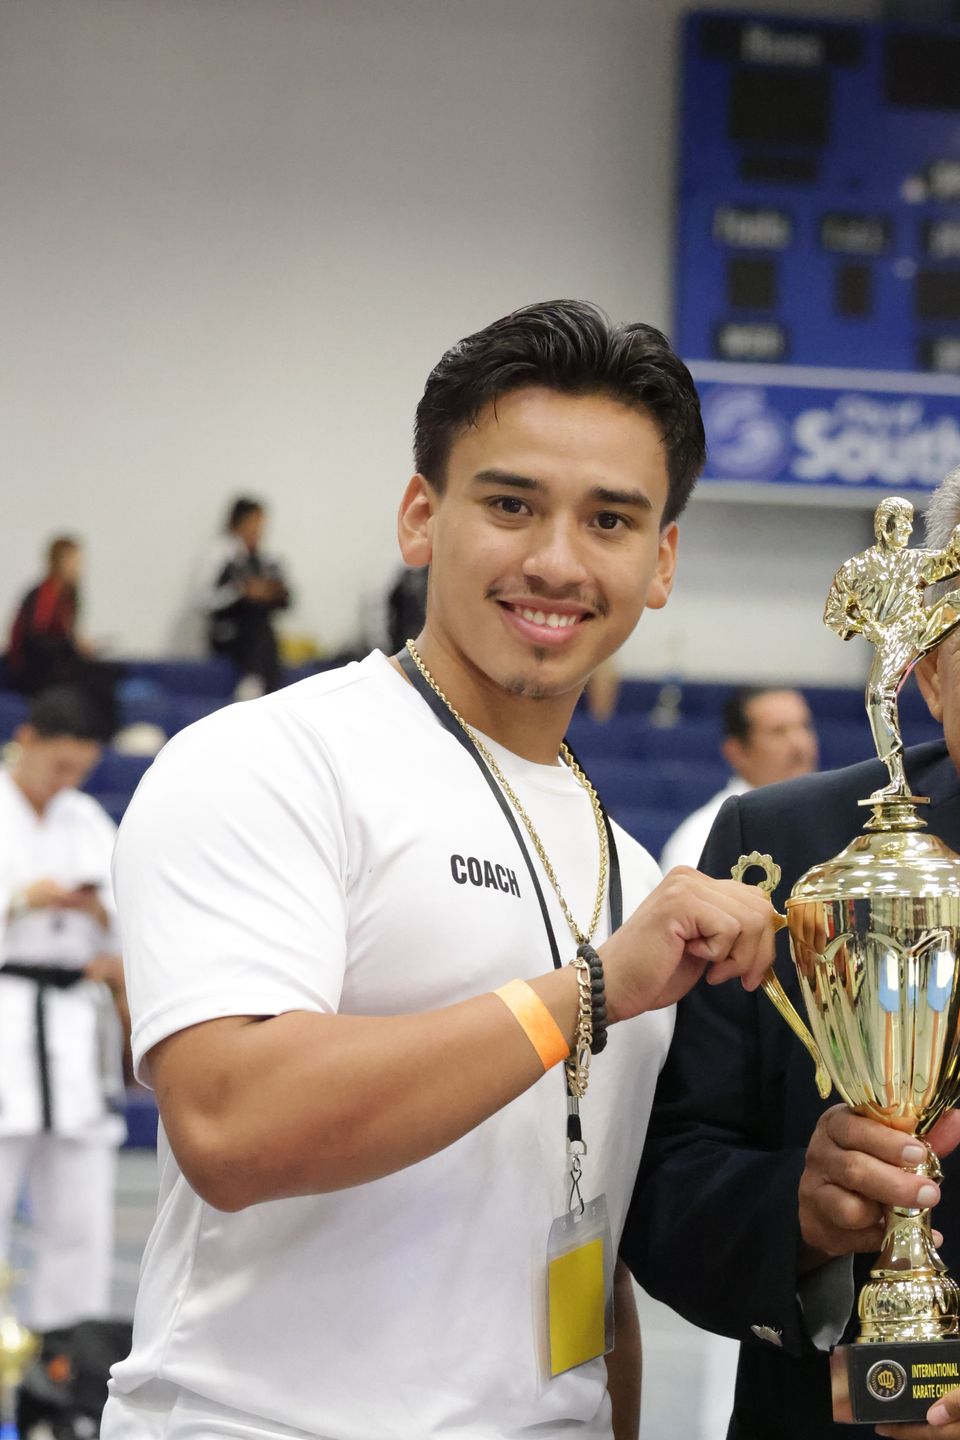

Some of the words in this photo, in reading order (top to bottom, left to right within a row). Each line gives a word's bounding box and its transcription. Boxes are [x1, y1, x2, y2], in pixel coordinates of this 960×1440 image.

[450, 854, 521, 899] COACH
[911, 1363, 959, 1378] INTERNATIONAL
[912, 1384, 935, 1399] KARATE
